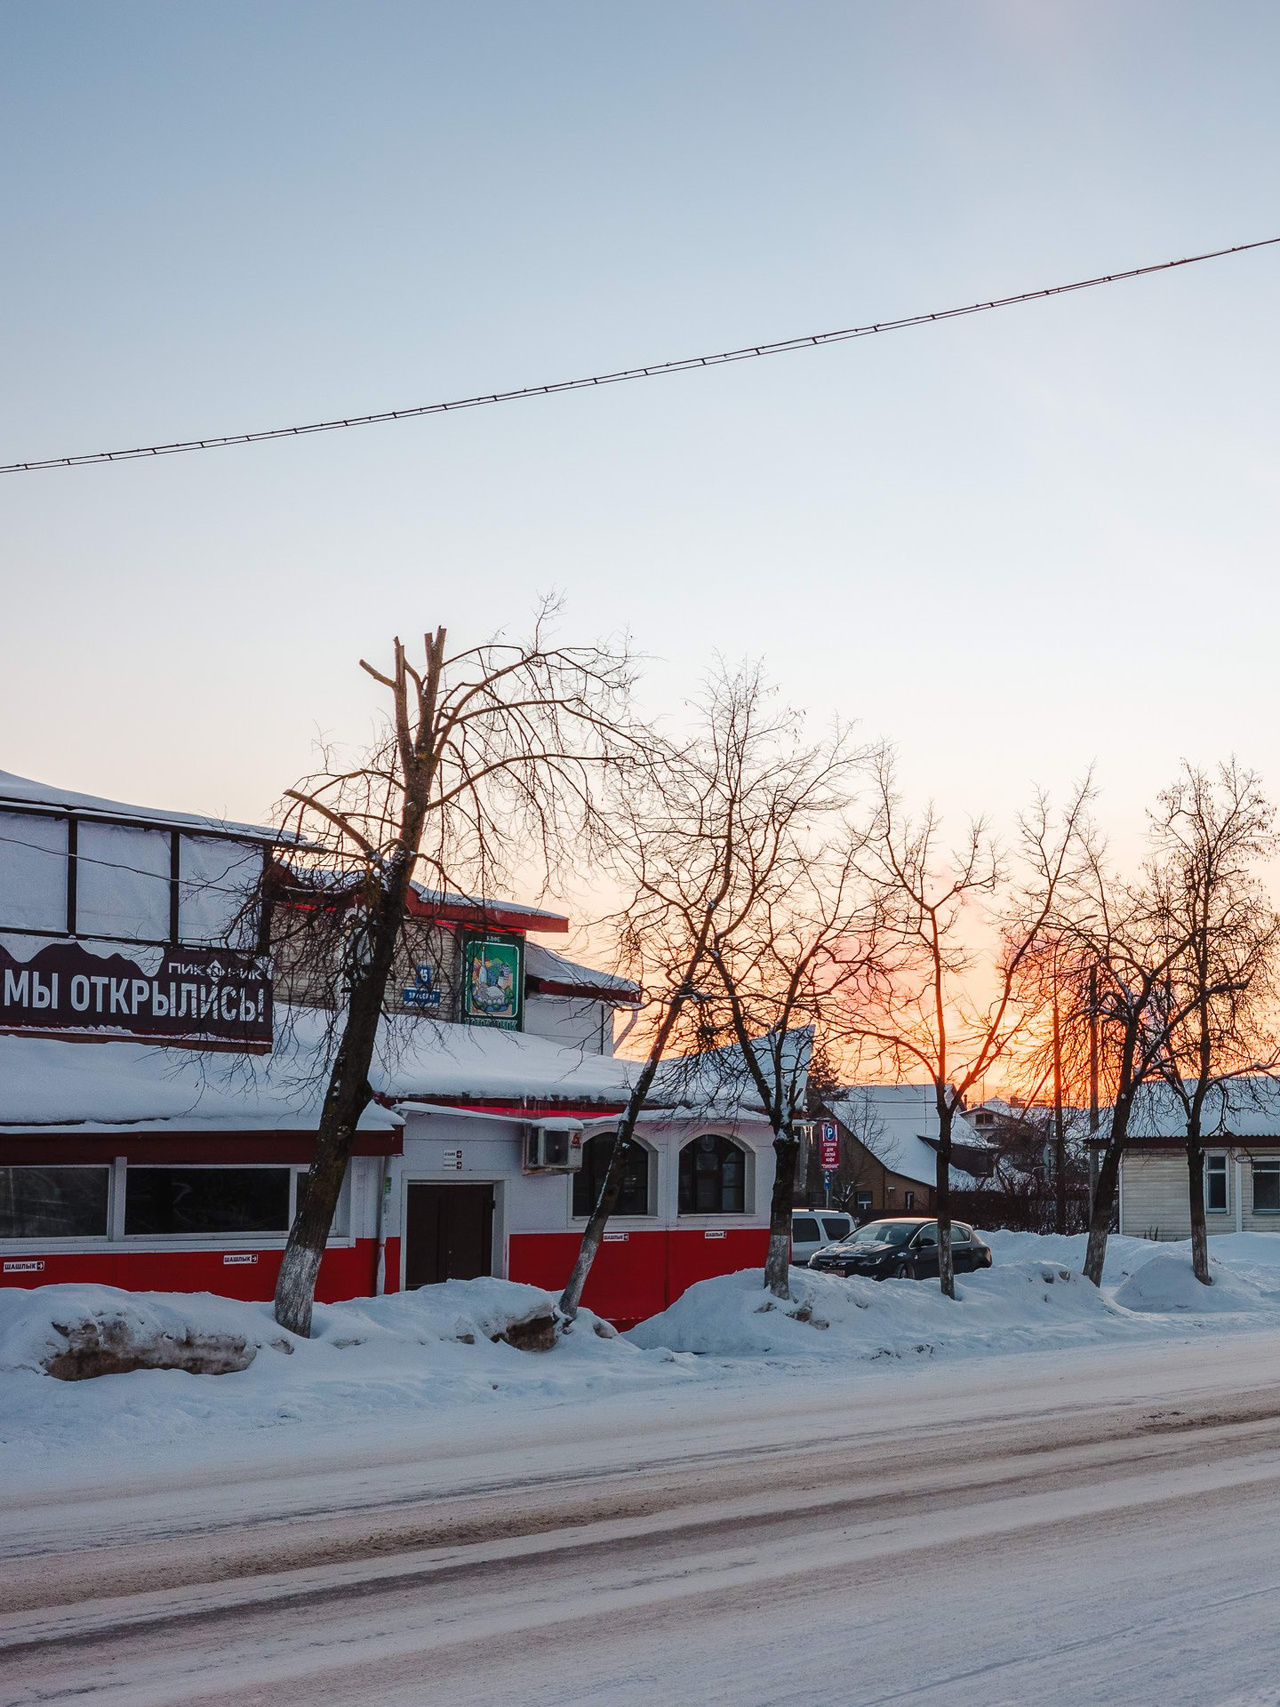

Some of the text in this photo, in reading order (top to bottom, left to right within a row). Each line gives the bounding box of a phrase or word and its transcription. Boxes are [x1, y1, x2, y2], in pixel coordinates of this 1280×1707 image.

[4, 968, 265, 1023] МЫ ОТКРЫЛИСЬ!
[827, 1128, 833, 1138] P
